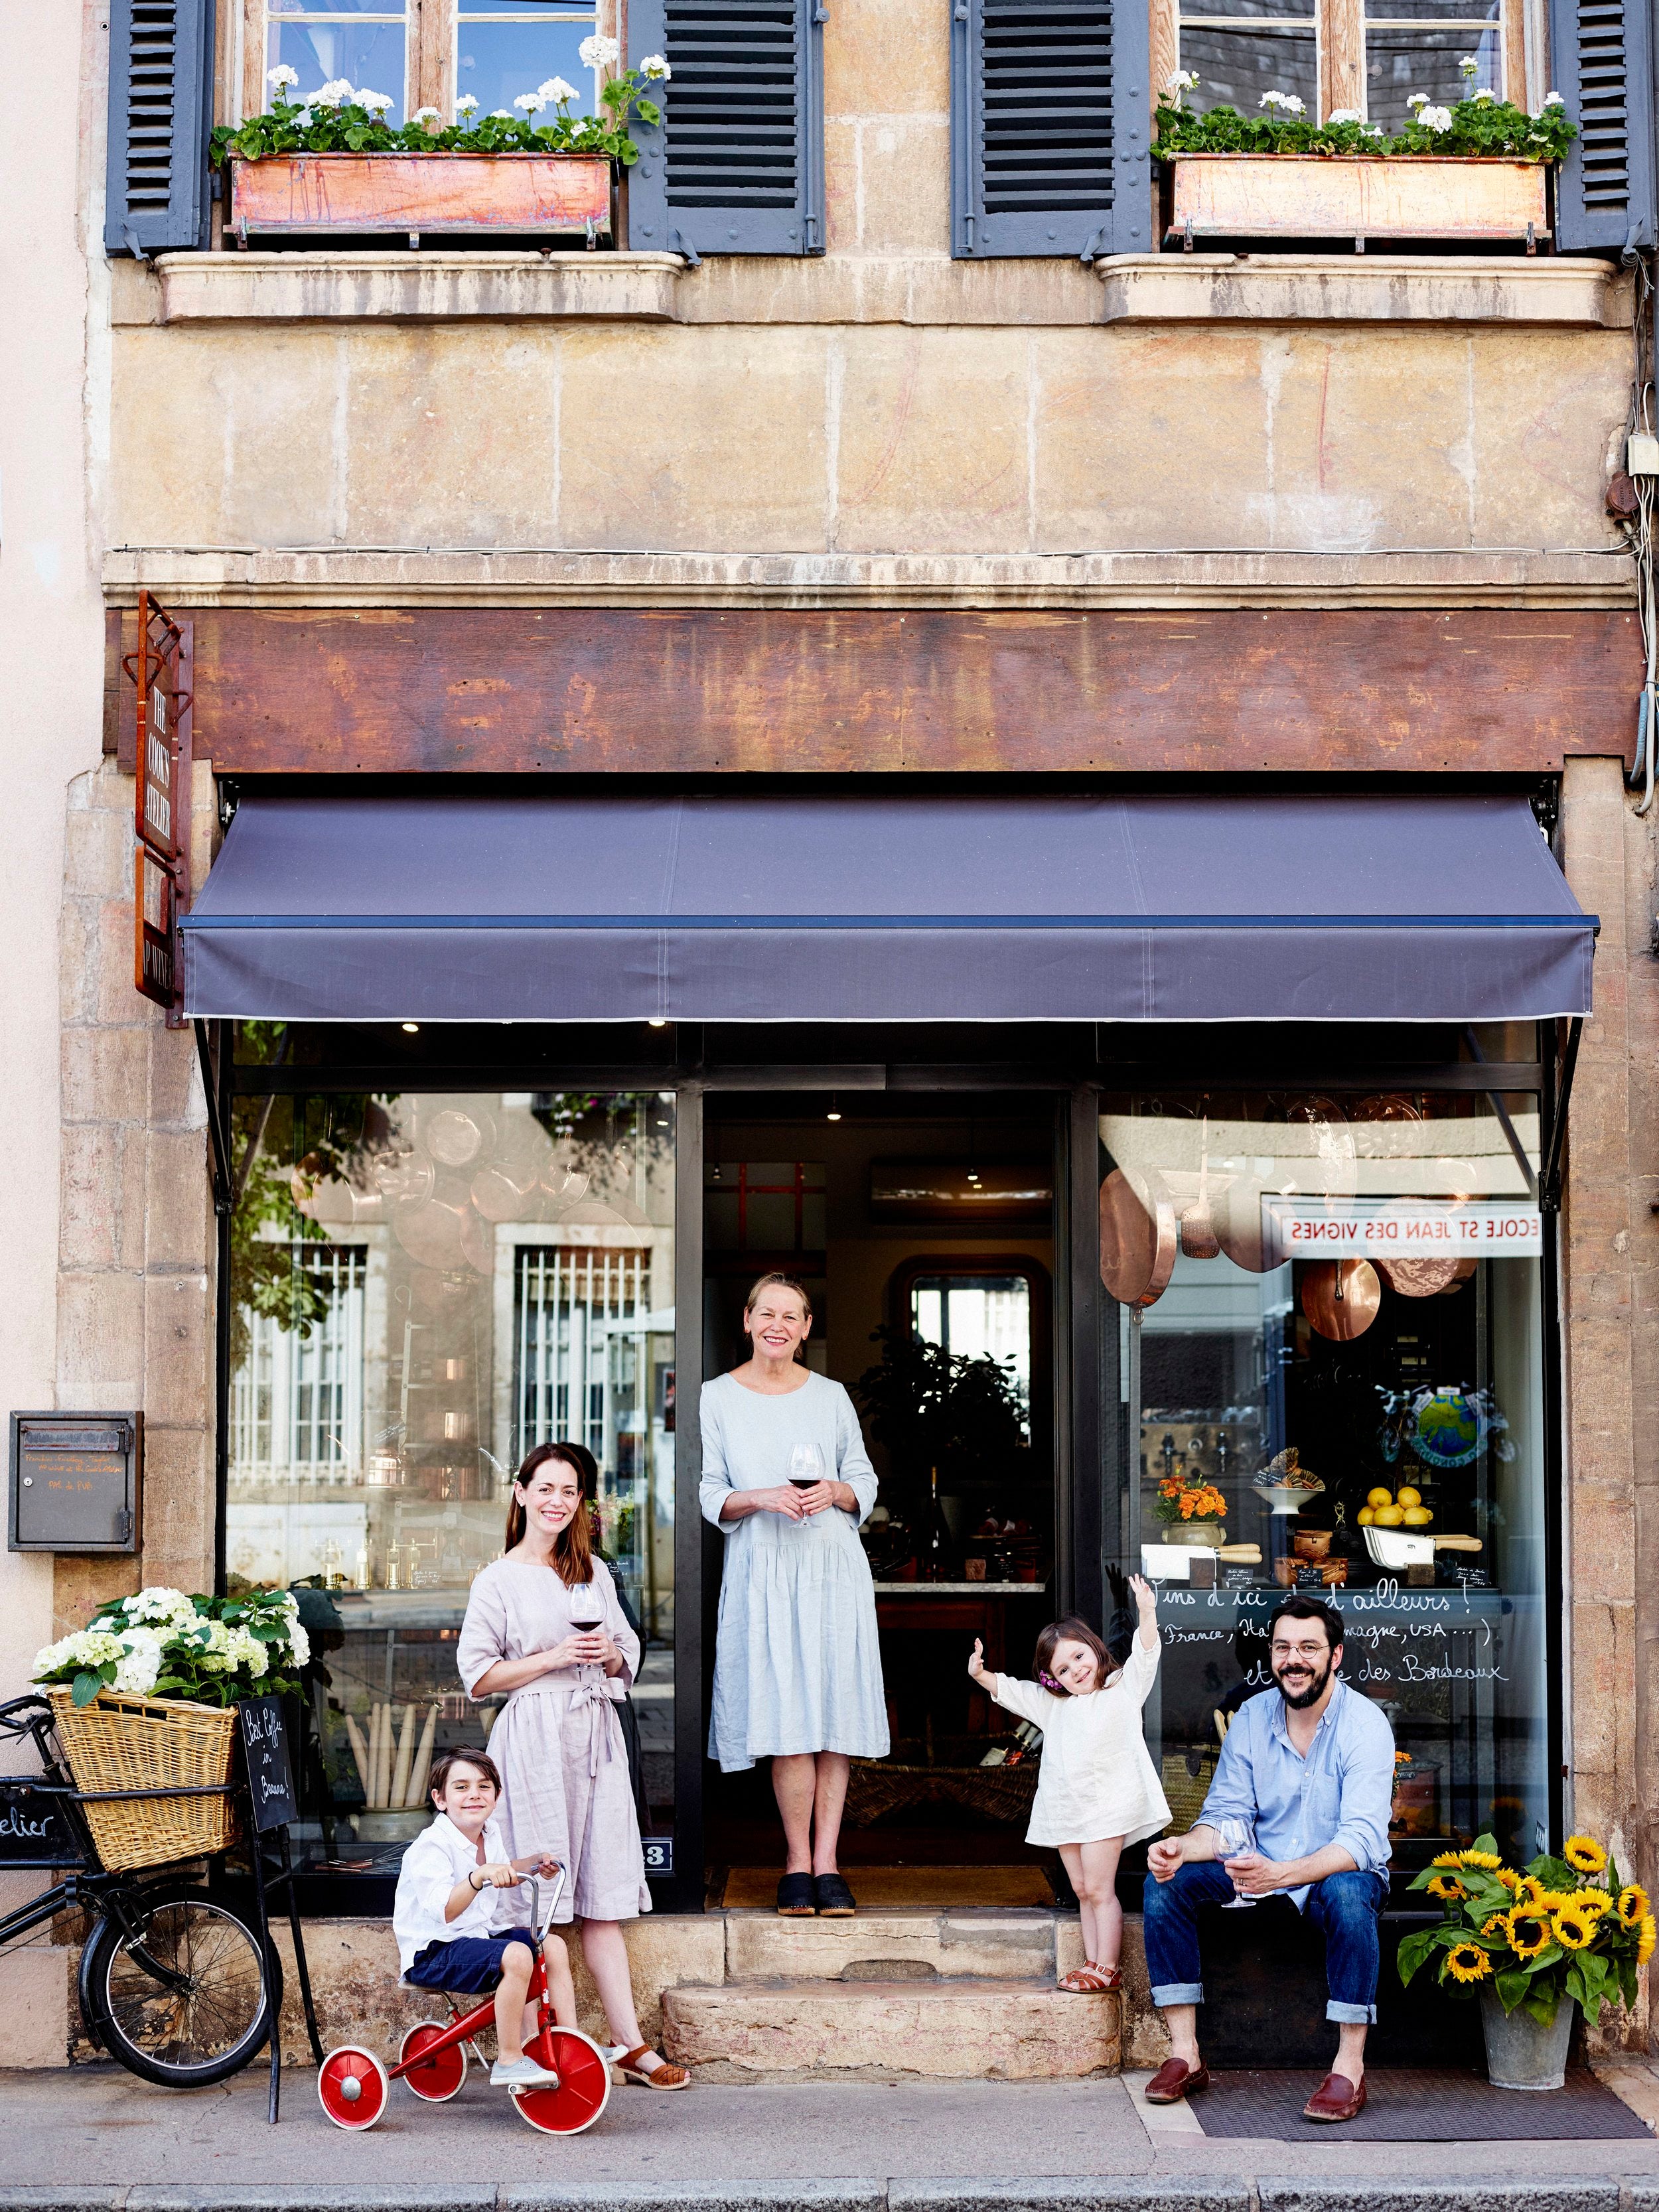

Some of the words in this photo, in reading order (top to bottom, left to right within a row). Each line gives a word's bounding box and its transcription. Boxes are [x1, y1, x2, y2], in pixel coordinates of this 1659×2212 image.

[154, 685, 166, 734] THE
[148, 732, 169, 788] COOK'S
[145, 780, 171, 841] ATELIER
[1409, 1622, 1447, 1637] USA
[1243, 1659, 1273, 1686] et
[1358, 1658, 1392, 1681] des
[1398, 1651, 1510, 1682] Bordeaux
[246, 1709, 263, 1747] Best
[263, 1707, 283, 1749] Coffee
[262, 1745, 272, 1765] in
